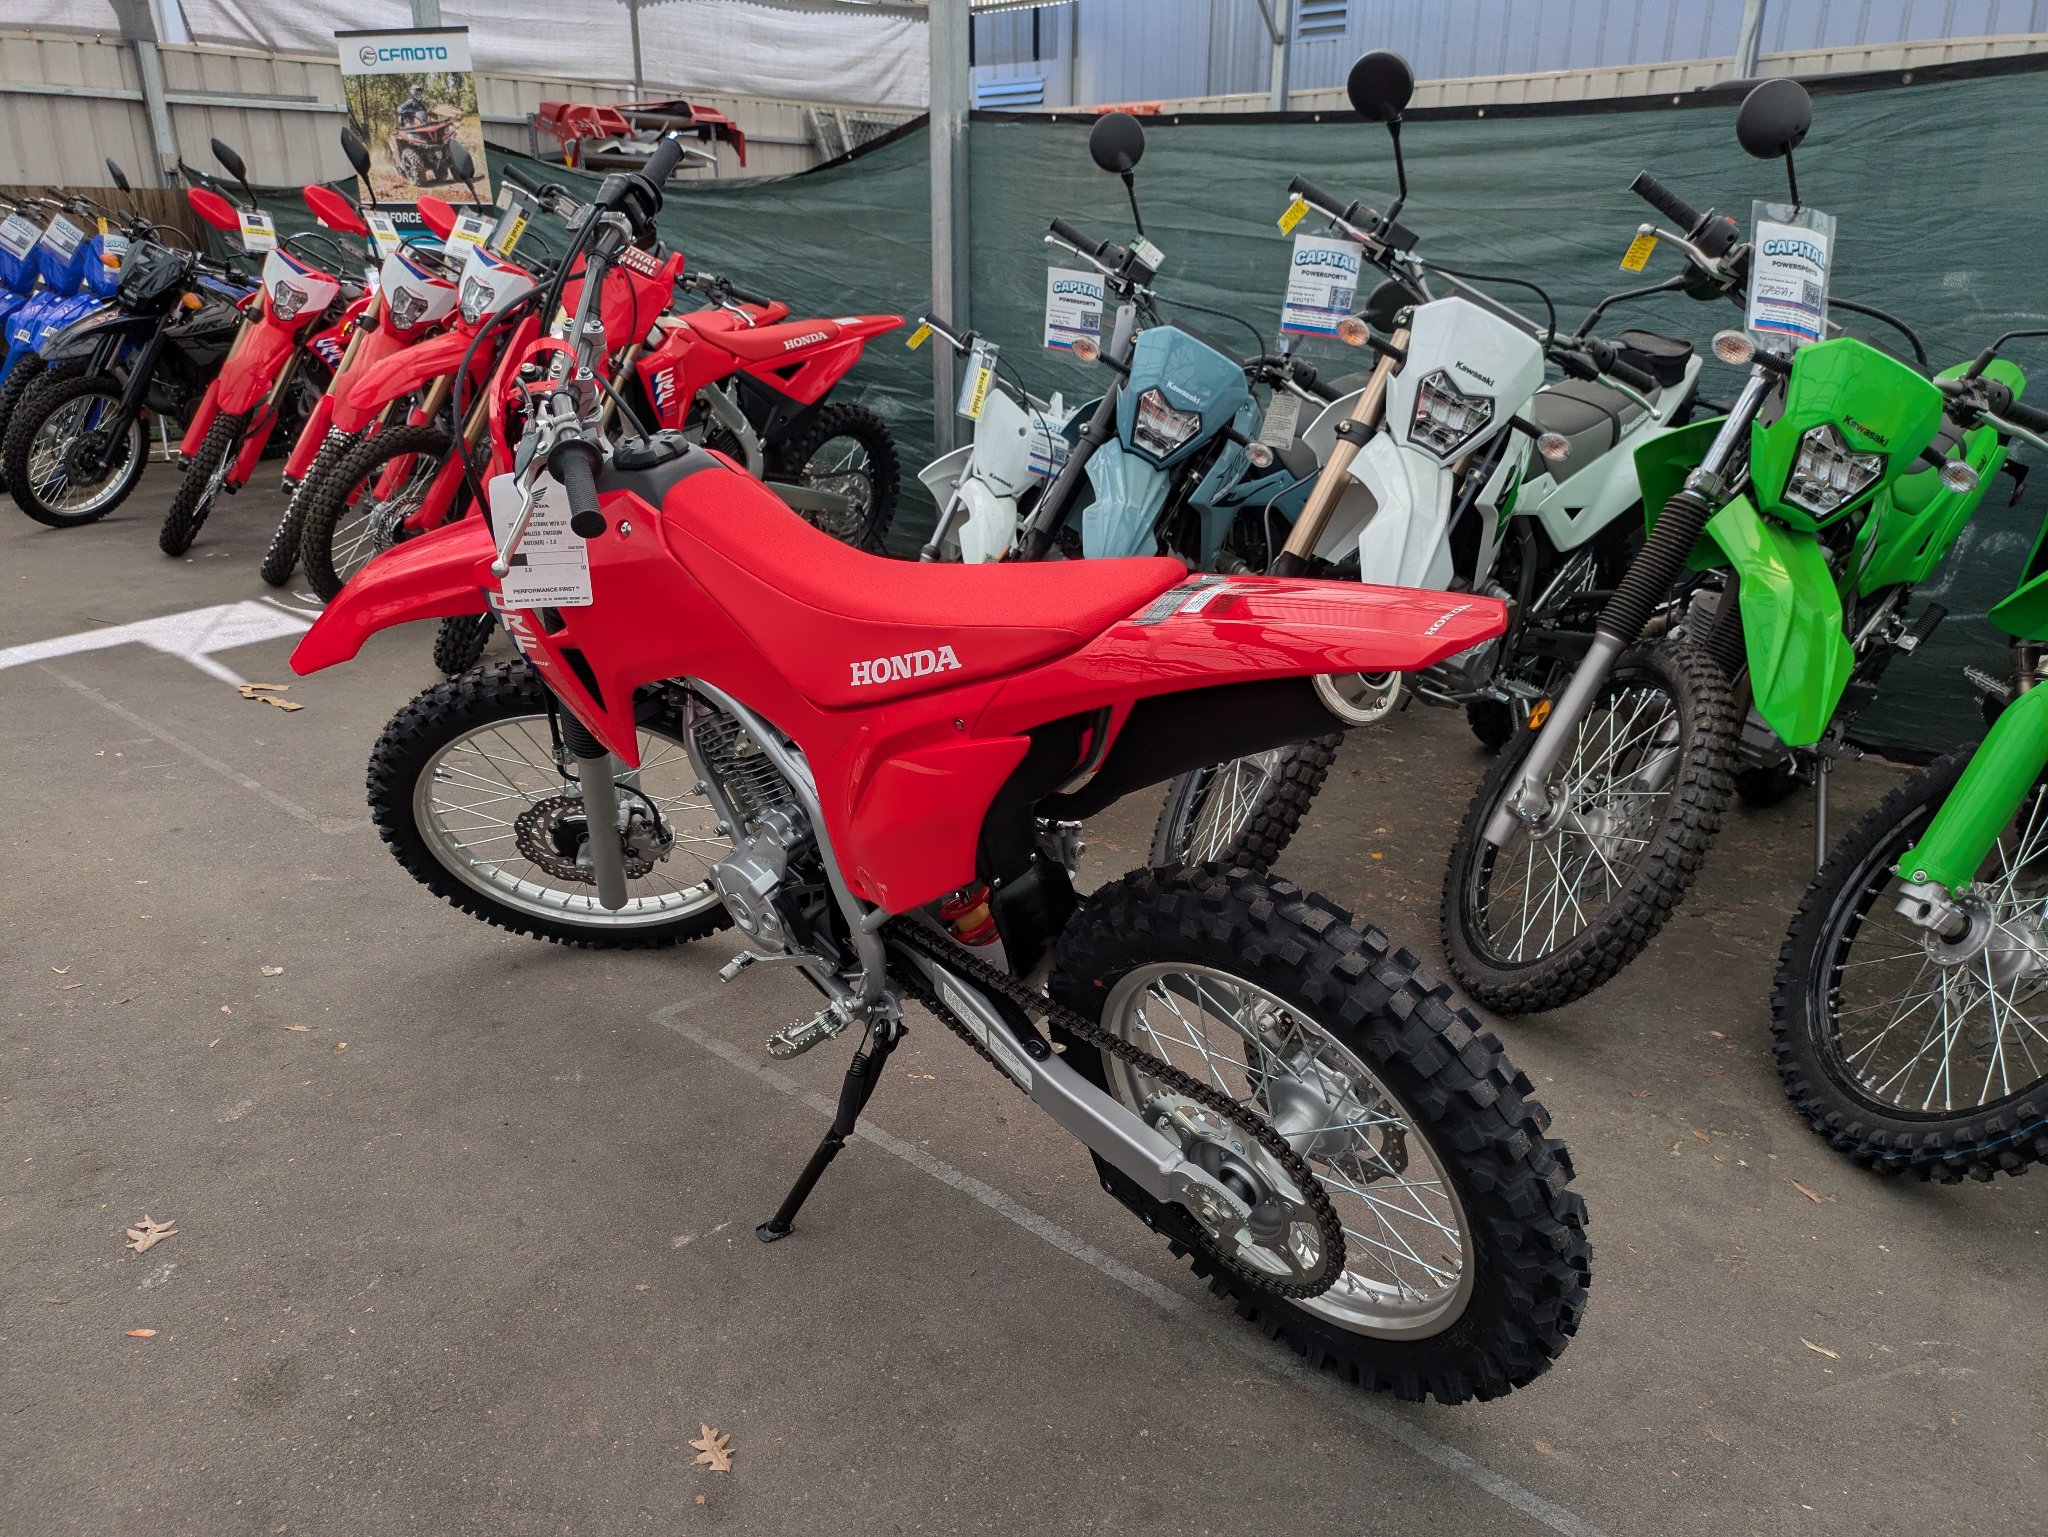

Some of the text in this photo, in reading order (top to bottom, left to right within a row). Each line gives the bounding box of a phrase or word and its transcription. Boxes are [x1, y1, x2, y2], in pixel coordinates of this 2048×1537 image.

[378, 47, 447, 61] CFMOTO
[1294, 249, 1358, 274] CAPITAL
[1763, 239, 1825, 270] CAPITAL
[1301, 269, 1348, 281] POWERSPORTS
[1772, 260, 1818, 277] POWERSPORTS
[1053, 280, 1104, 300] CAPITAL
[1059, 296, 1096, 307] POWERSPORTS
[783, 331, 828, 350] HONDA
[977, 372, 988, 395] Recall
[1455, 360, 1494, 387] Kawasaki
[1166, 380, 1201, 404] Kawasaki
[972, 395, 983, 414] Hold
[1843, 414, 1889, 448] Kawasaki
[989, 472, 1014, 489] Kawasaki
[513, 586, 558, 595] PERFORMANCE
[1424, 603, 1473, 635] HONDA
[850, 645, 962, 687] HONDA
